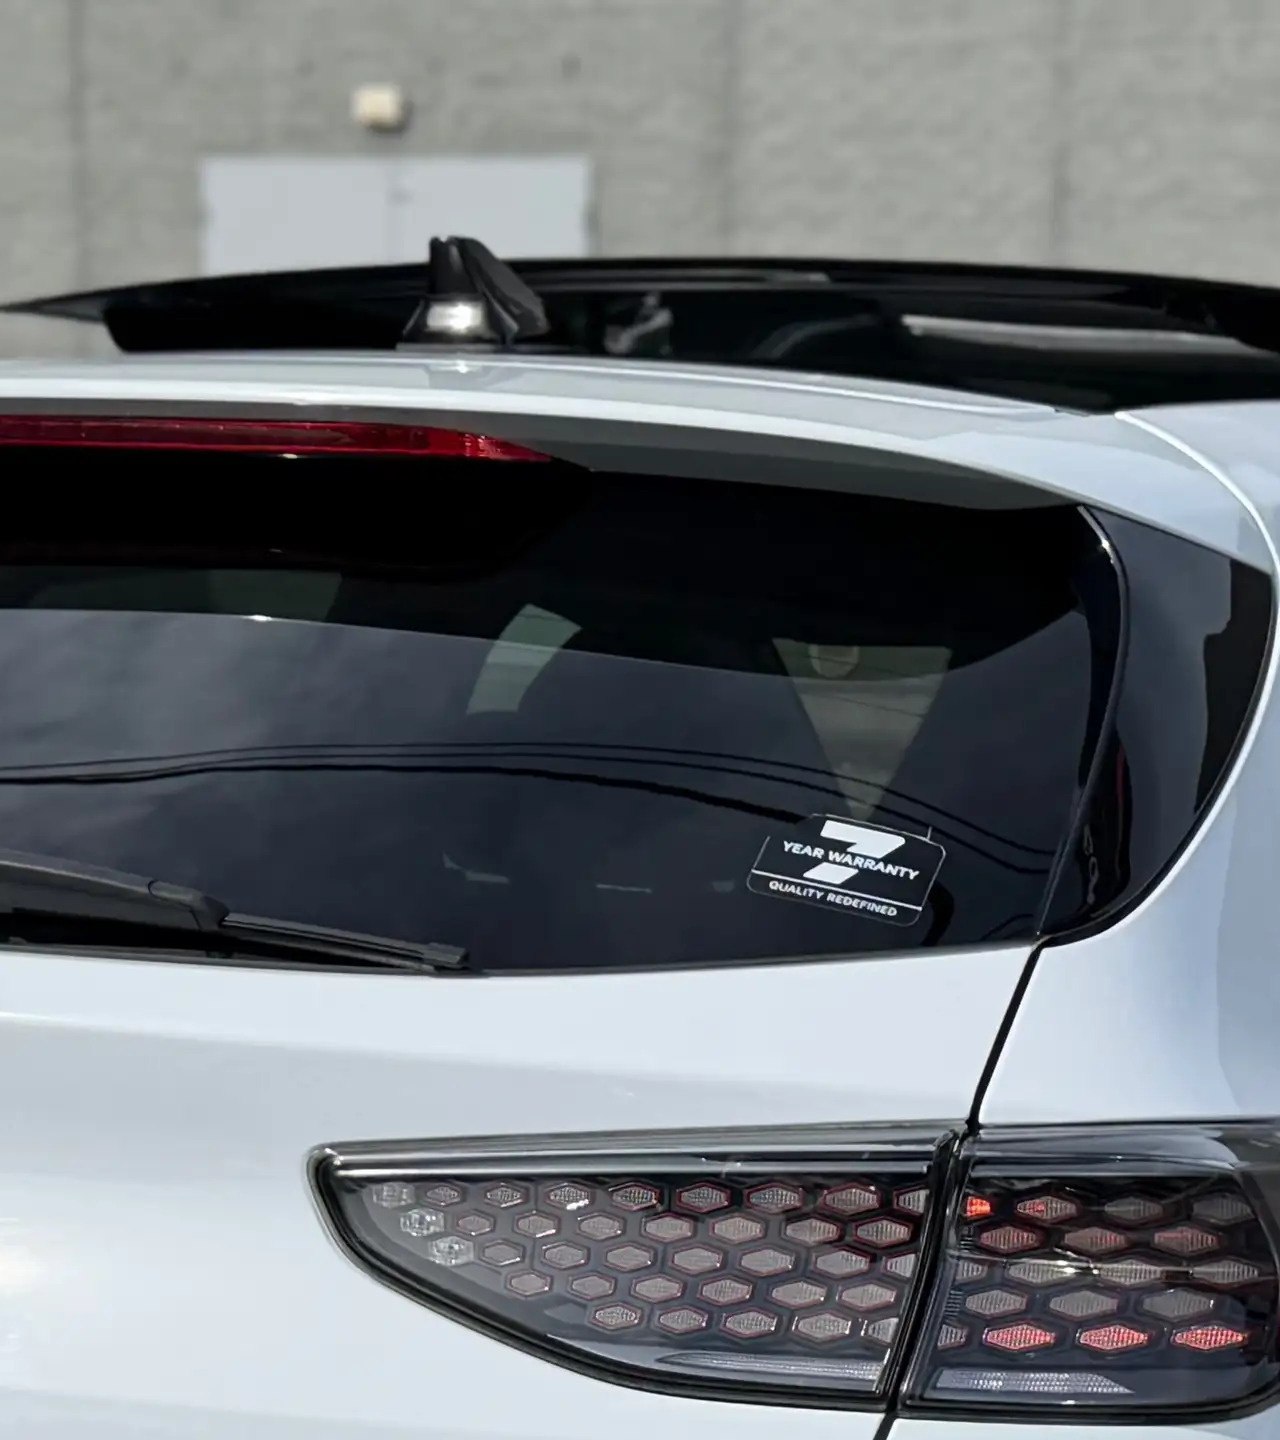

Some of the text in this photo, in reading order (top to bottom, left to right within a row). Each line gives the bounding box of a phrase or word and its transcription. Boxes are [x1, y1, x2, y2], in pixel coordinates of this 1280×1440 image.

[783, 840, 920, 881] YEAR WARRANTY
[769, 880, 898, 917] QUALITY REDEFINED
